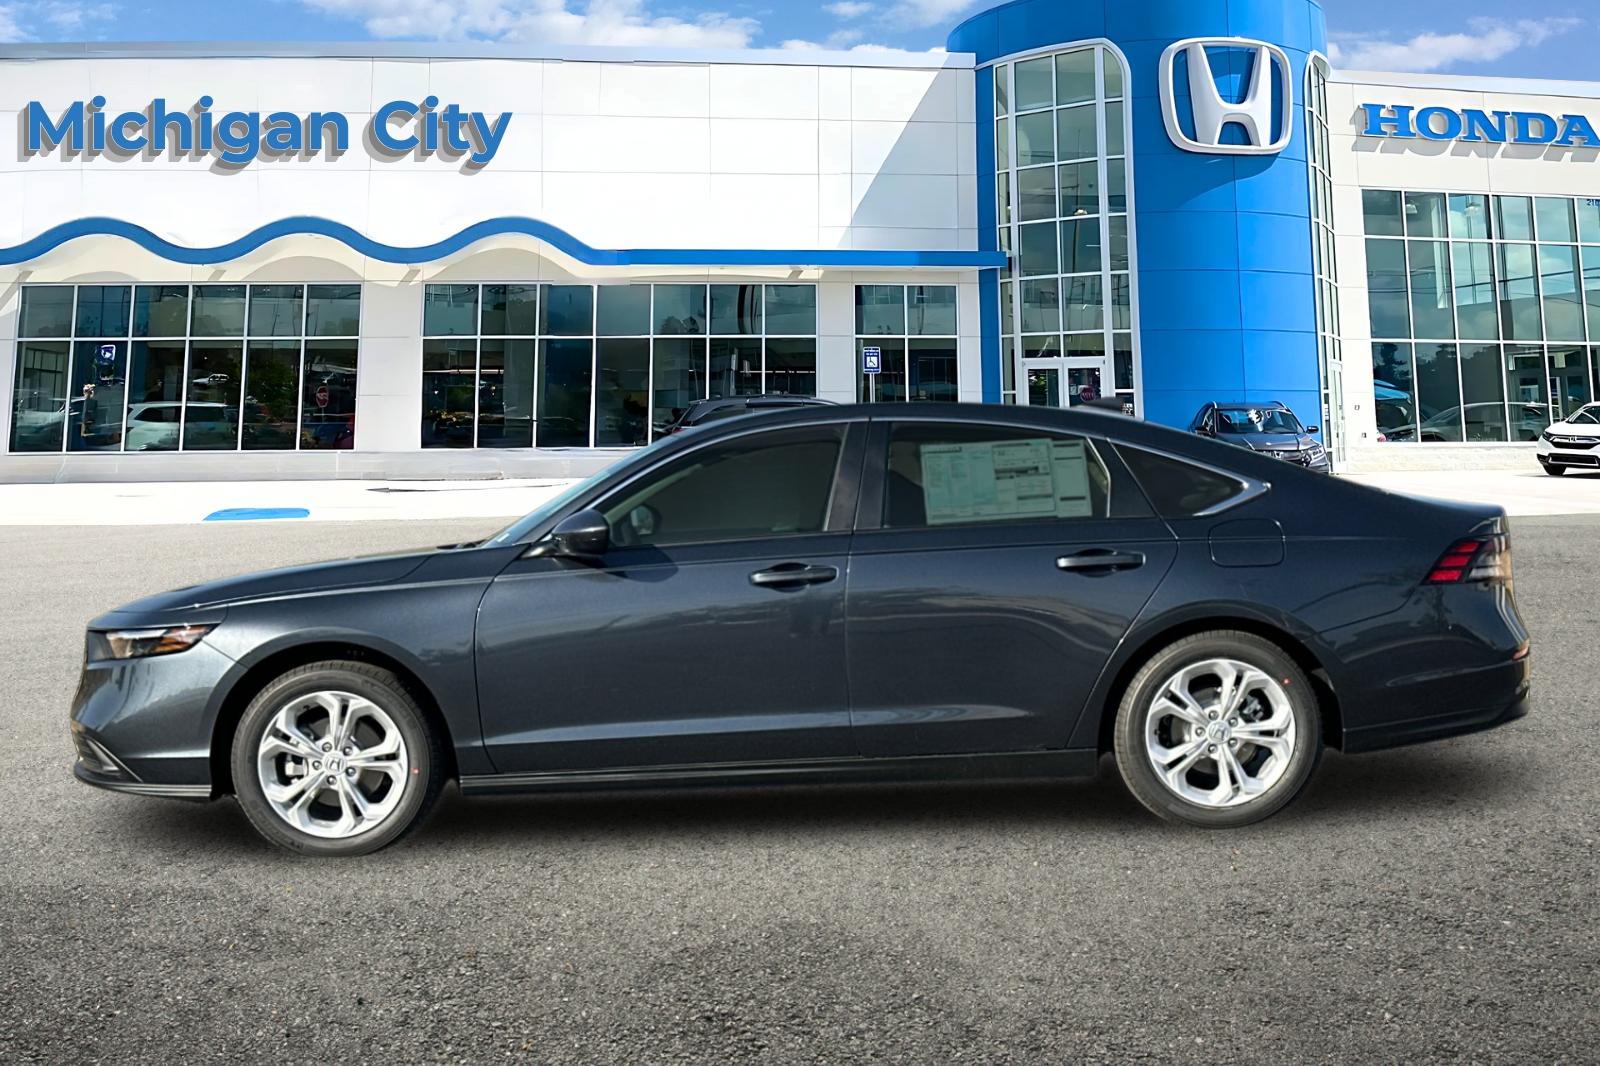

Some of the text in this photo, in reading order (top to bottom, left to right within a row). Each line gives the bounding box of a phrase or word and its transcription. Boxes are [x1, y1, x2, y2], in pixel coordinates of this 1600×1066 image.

[28, 95, 512, 164] Michigan City
[1361, 103, 1600, 147] HONDA
